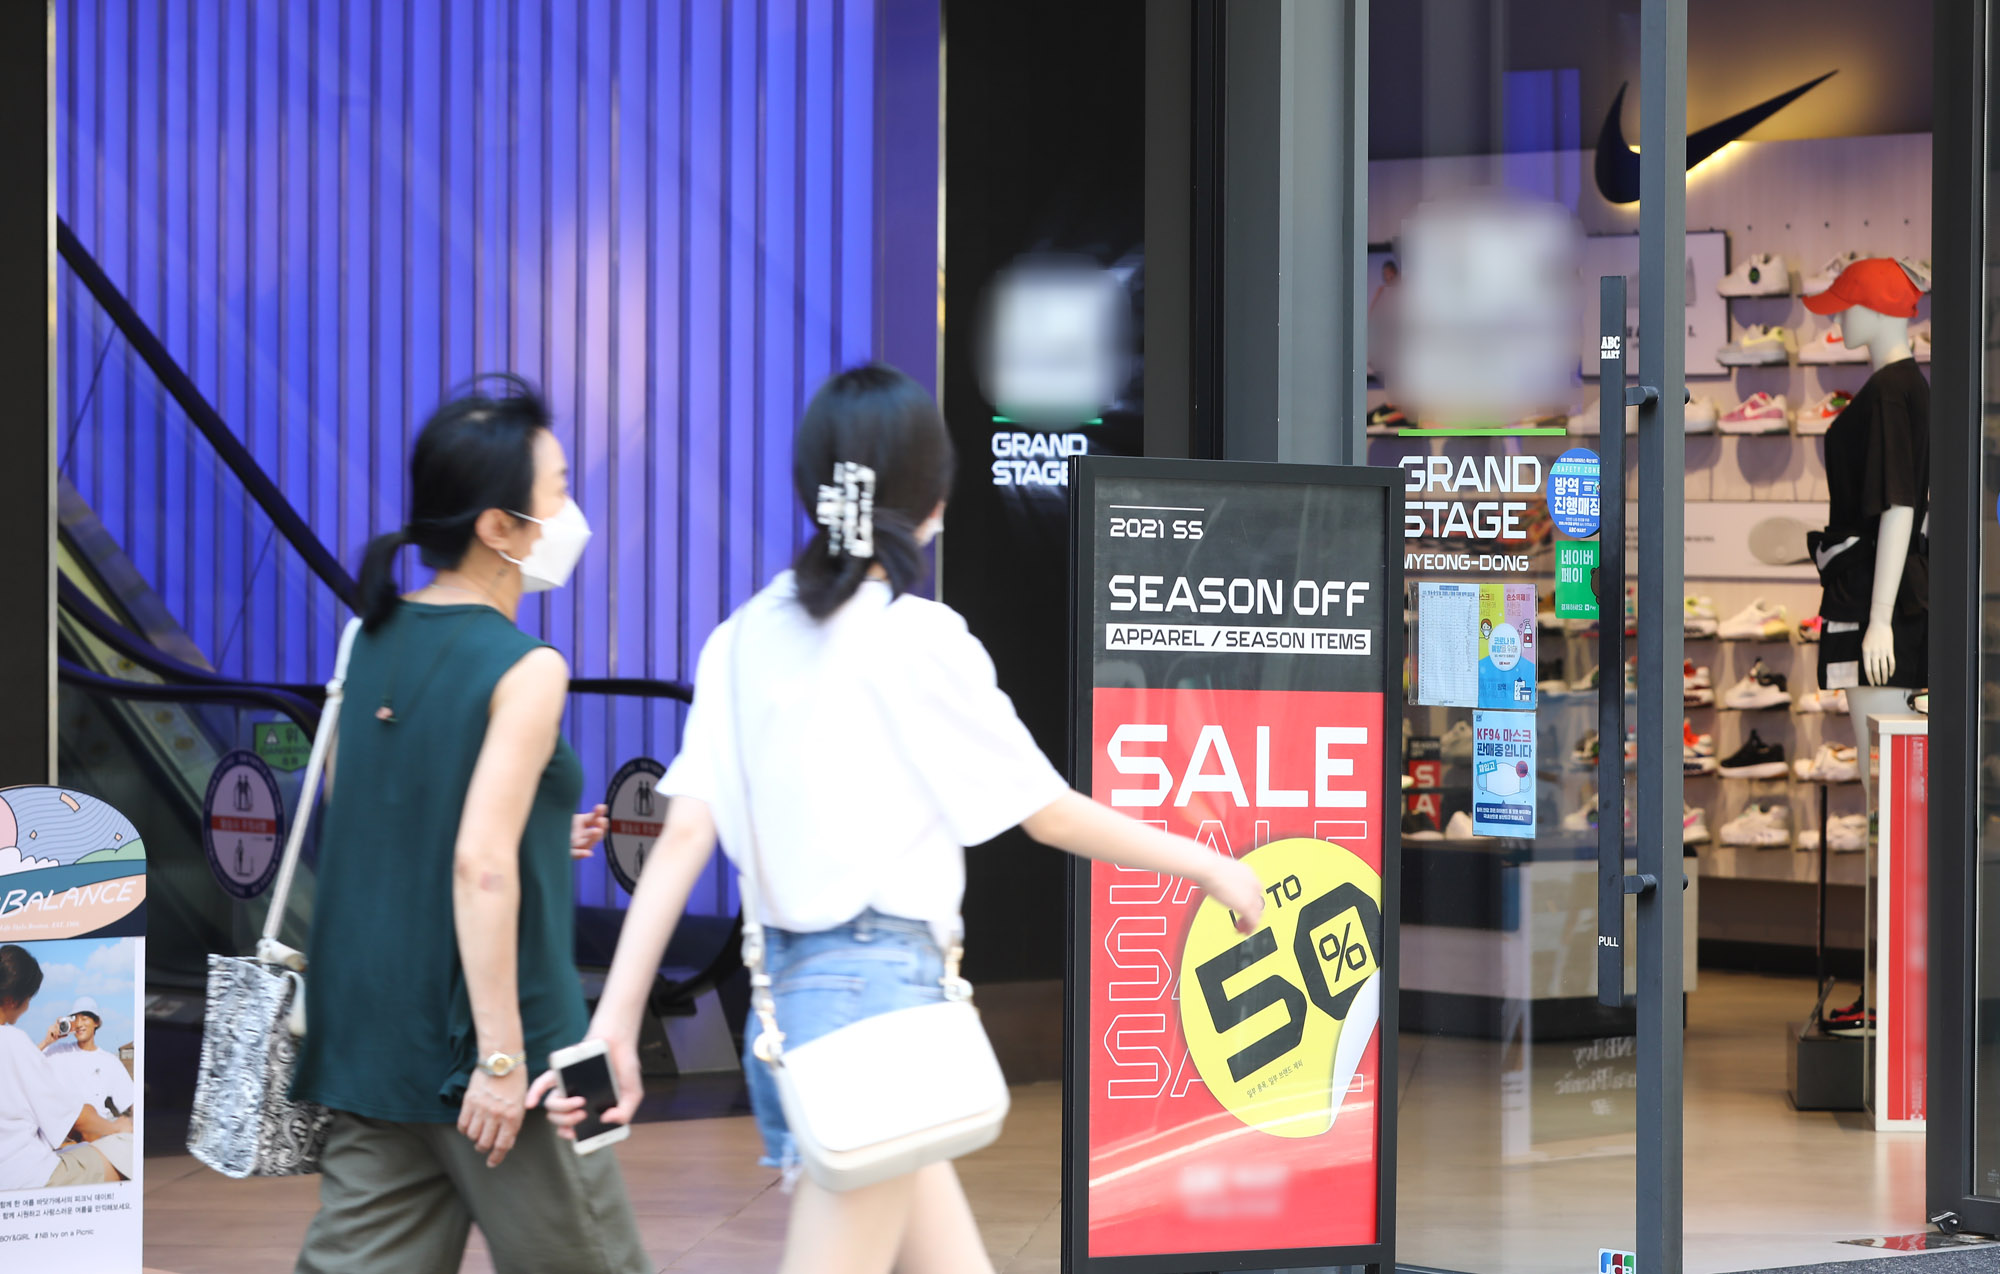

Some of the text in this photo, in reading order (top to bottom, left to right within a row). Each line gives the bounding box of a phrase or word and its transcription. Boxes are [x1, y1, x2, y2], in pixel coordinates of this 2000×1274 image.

[1601, 336, 1620, 349] ABC
[1601, 350, 1620, 359] MART
[992, 432, 1088, 457] GRAND
[1398, 456, 1541, 492] GRAND
[1556, 465, 1581, 473] SAFETY
[1554, 477, 1579, 496] 방역
[1110, 518, 1204, 539] 2021 SS
[1404, 502, 1527, 539] STAGE
[1561, 549, 1593, 565] 네이버
[1561, 567, 1583, 583] 페이
[1108, 575, 1370, 617] SEASON OFF
[1111, 628, 1204, 647] APPAREL
[1225, 631, 1305, 649] SEASON
[1311, 634, 1366, 650] ITEMS
[1477, 728, 1532, 742] KF94 마스크
[1107, 723, 1368, 807] SALE
[0, 881, 137, 918] BALANCE
[1266, 874, 1301, 909] TO
[1598, 936, 1619, 947] PULL
